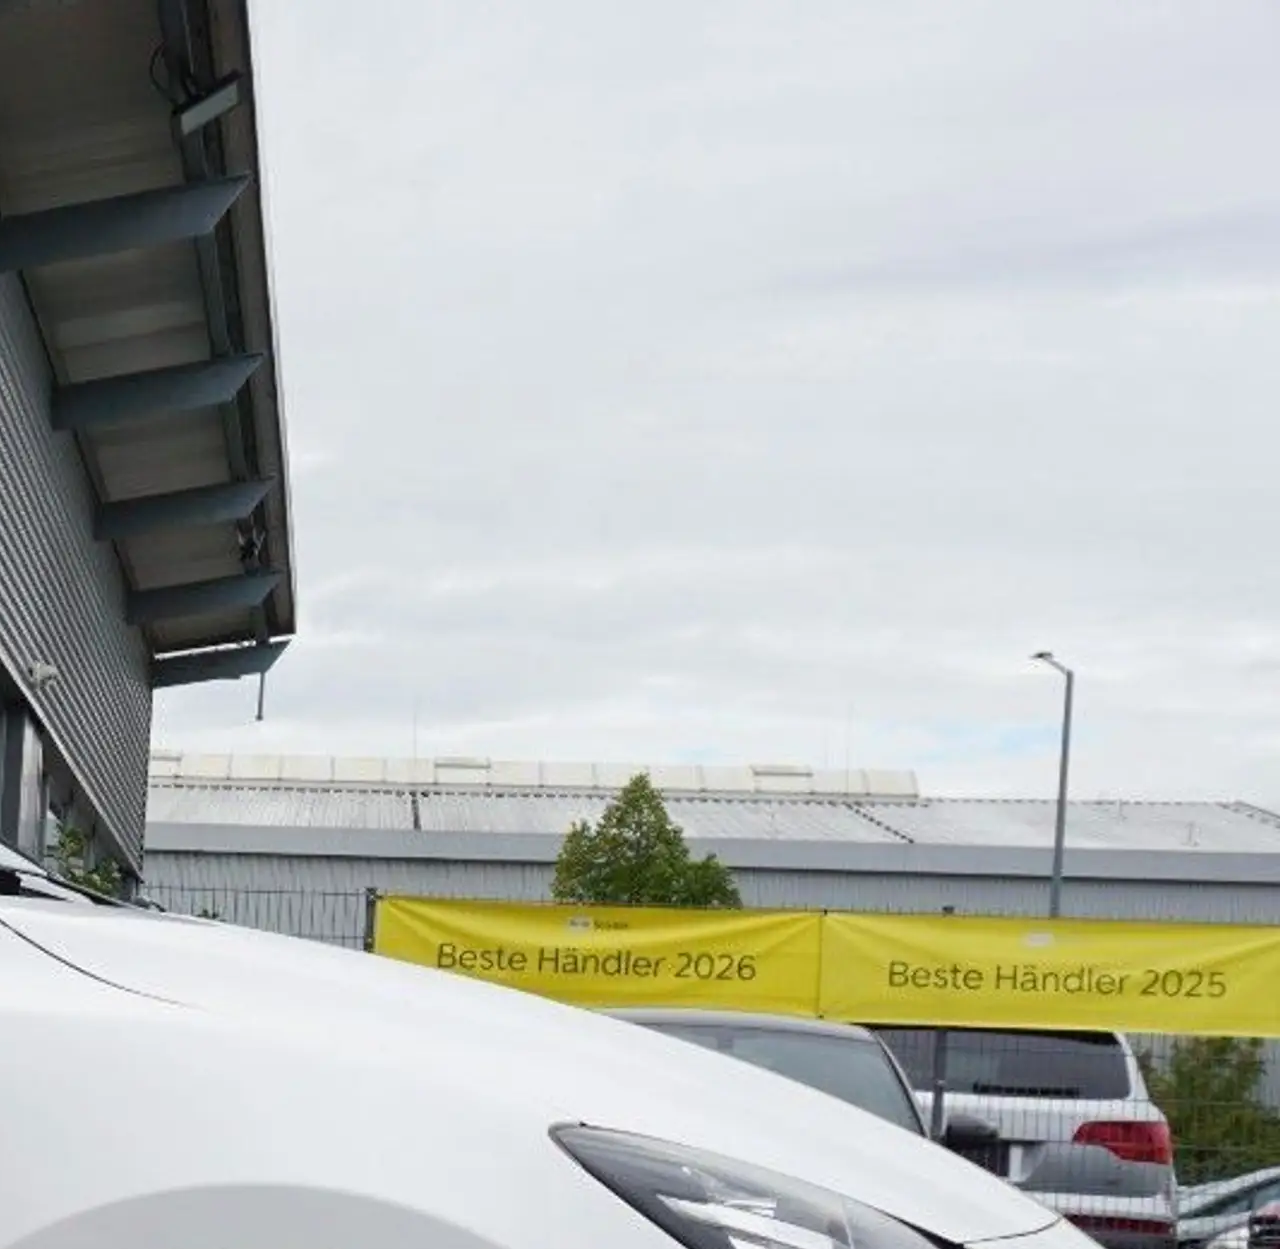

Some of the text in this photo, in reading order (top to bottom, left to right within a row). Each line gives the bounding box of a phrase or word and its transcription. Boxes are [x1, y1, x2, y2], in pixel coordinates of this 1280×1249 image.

[437, 943, 757, 981] Beste Händler 2026
[889, 960, 1227, 998] Beste Händler 2025
